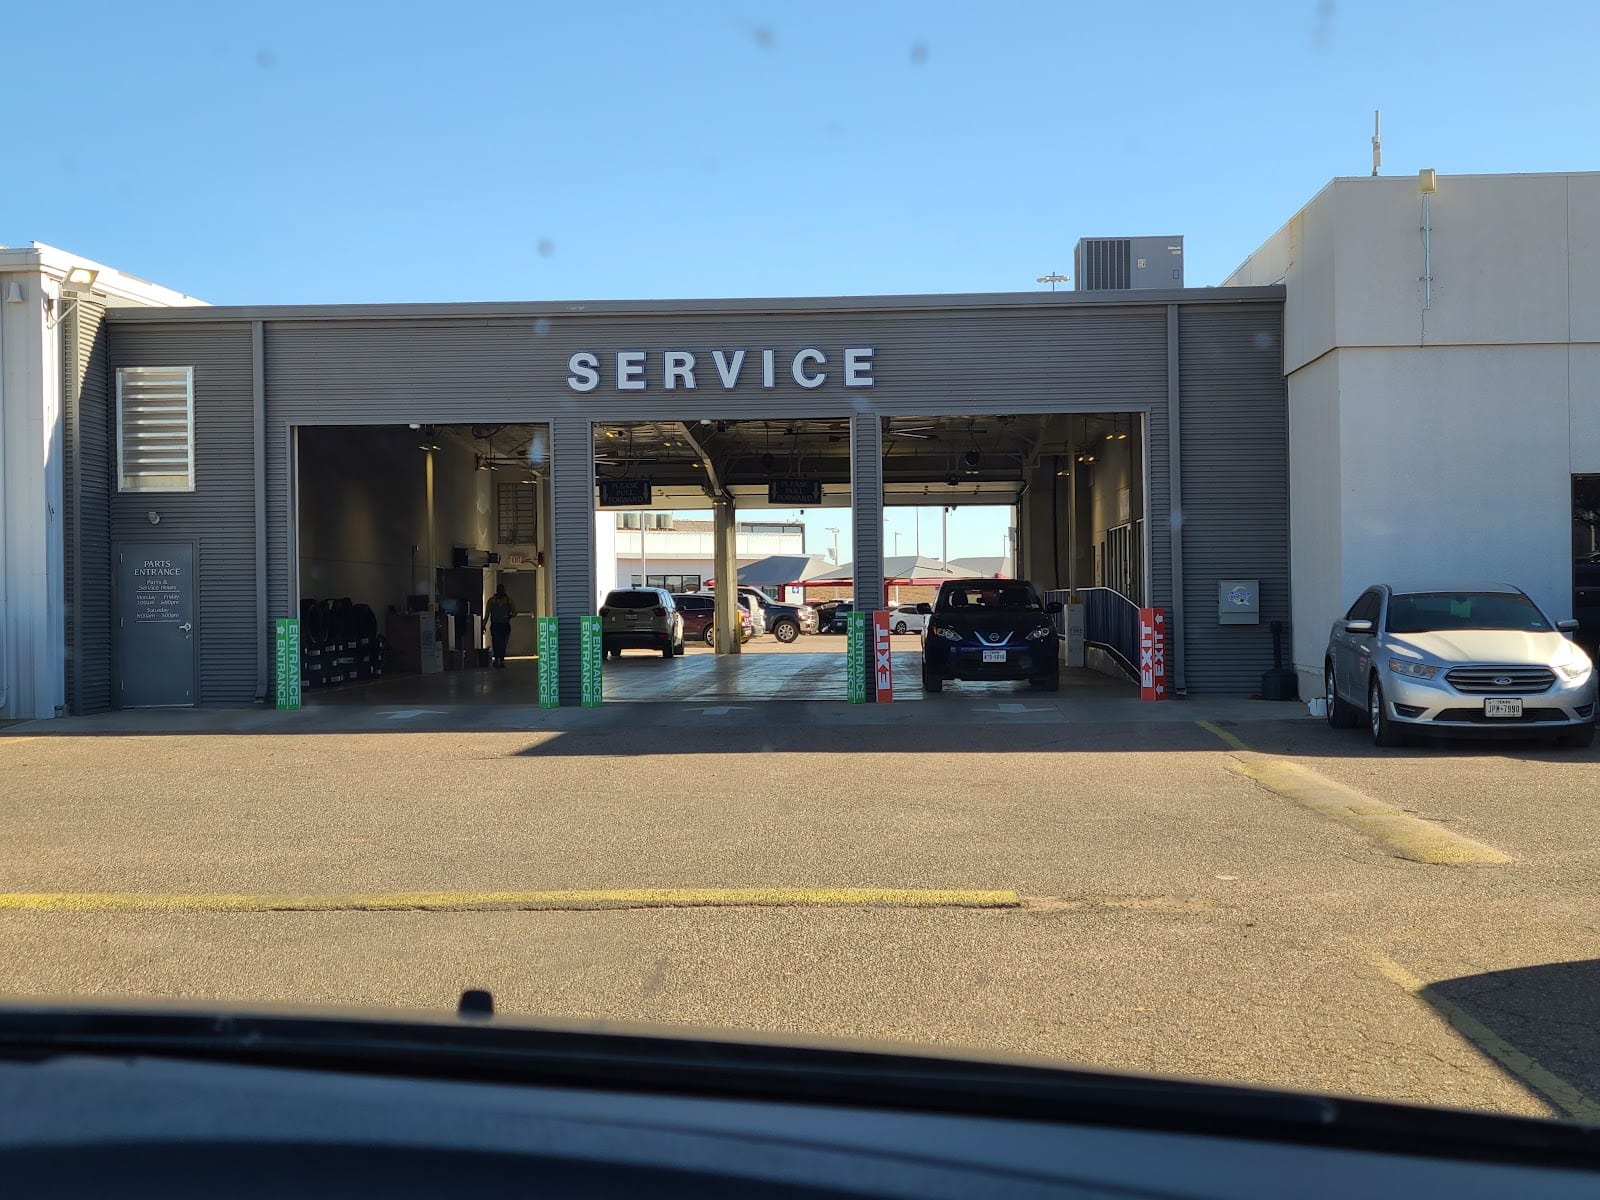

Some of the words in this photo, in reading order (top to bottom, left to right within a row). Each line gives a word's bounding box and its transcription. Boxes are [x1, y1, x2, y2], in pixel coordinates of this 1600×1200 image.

[566, 347, 875, 393] SERVICE
[134, 568, 180, 576] ENTRANCE
[277, 639, 286, 705] ENTRANCE
[289, 624, 299, 705] ENTRANCE
[539, 622, 548, 704] ENTRANCE
[550, 637, 559, 704] ENTRANCE
[582, 621, 591, 703] ENTRANCE
[593, 636, 602, 703] ENTRANCE
[847, 617, 855, 699] ENTRANCE
[855, 632, 865, 700] ENTRANCE
[876, 623, 891, 690] EXIT
[1141, 620, 1153, 688] EXIT
[1154, 630, 1164, 677] EXIT
